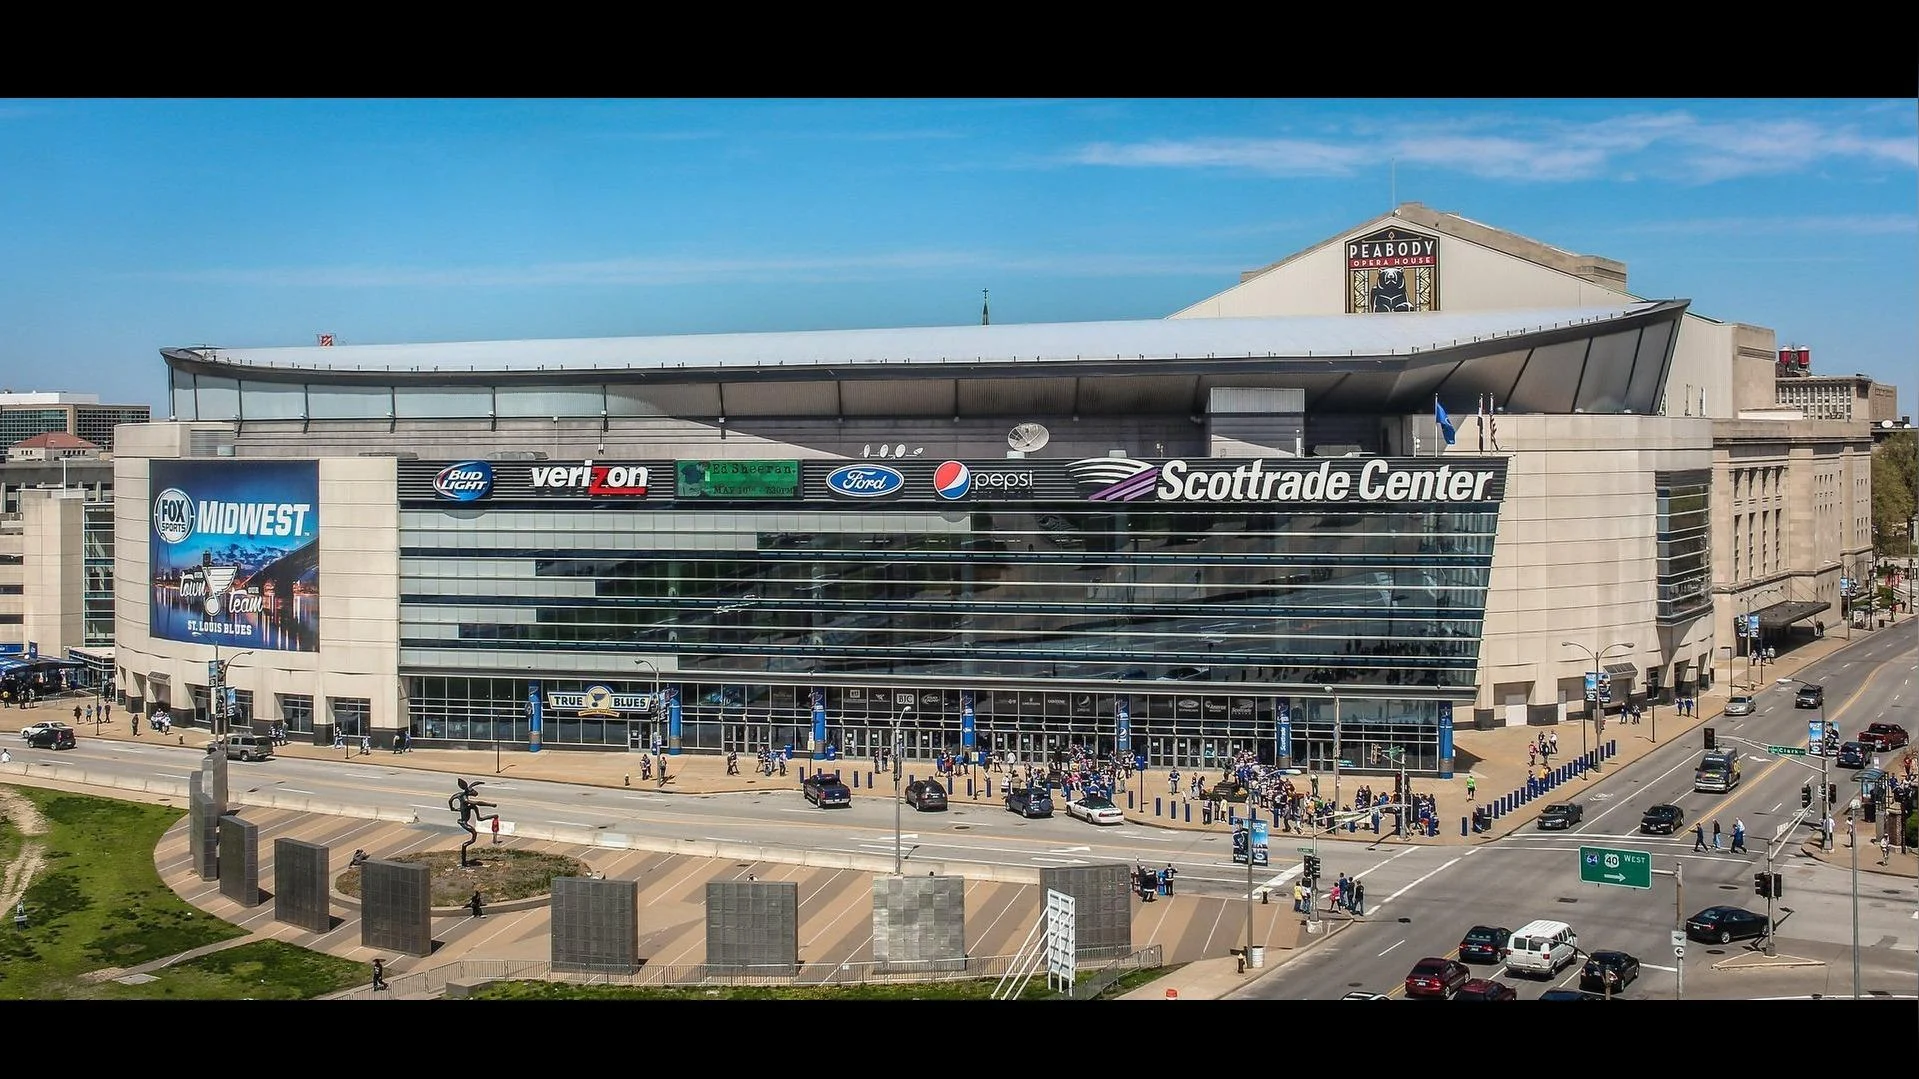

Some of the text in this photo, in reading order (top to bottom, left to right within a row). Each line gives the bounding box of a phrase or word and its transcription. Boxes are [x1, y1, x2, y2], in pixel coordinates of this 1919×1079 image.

[1349, 240, 1434, 258] PEABODY
[1353, 256, 1431, 267] OPERA HOUSE
[449, 469, 483, 481] BUD
[531, 459, 649, 495] verizon
[712, 463, 728, 475] Ed
[441, 479, 487, 490] LIGHT
[842, 469, 887, 491] Ford
[975, 470, 1033, 490] pepsi
[1156, 458, 1351, 502] Scottrade
[161, 499, 186, 523] FOX
[196, 500, 310, 537] MIDWEST
[161, 522, 186, 533] SPORTS
[228, 587, 264, 613] team
[187, 620, 252, 636] ST. LOUIS BLUES
[554, 696, 646, 707] TRUE BLUES
[1586, 854, 1646, 866] 64 40 WEST
